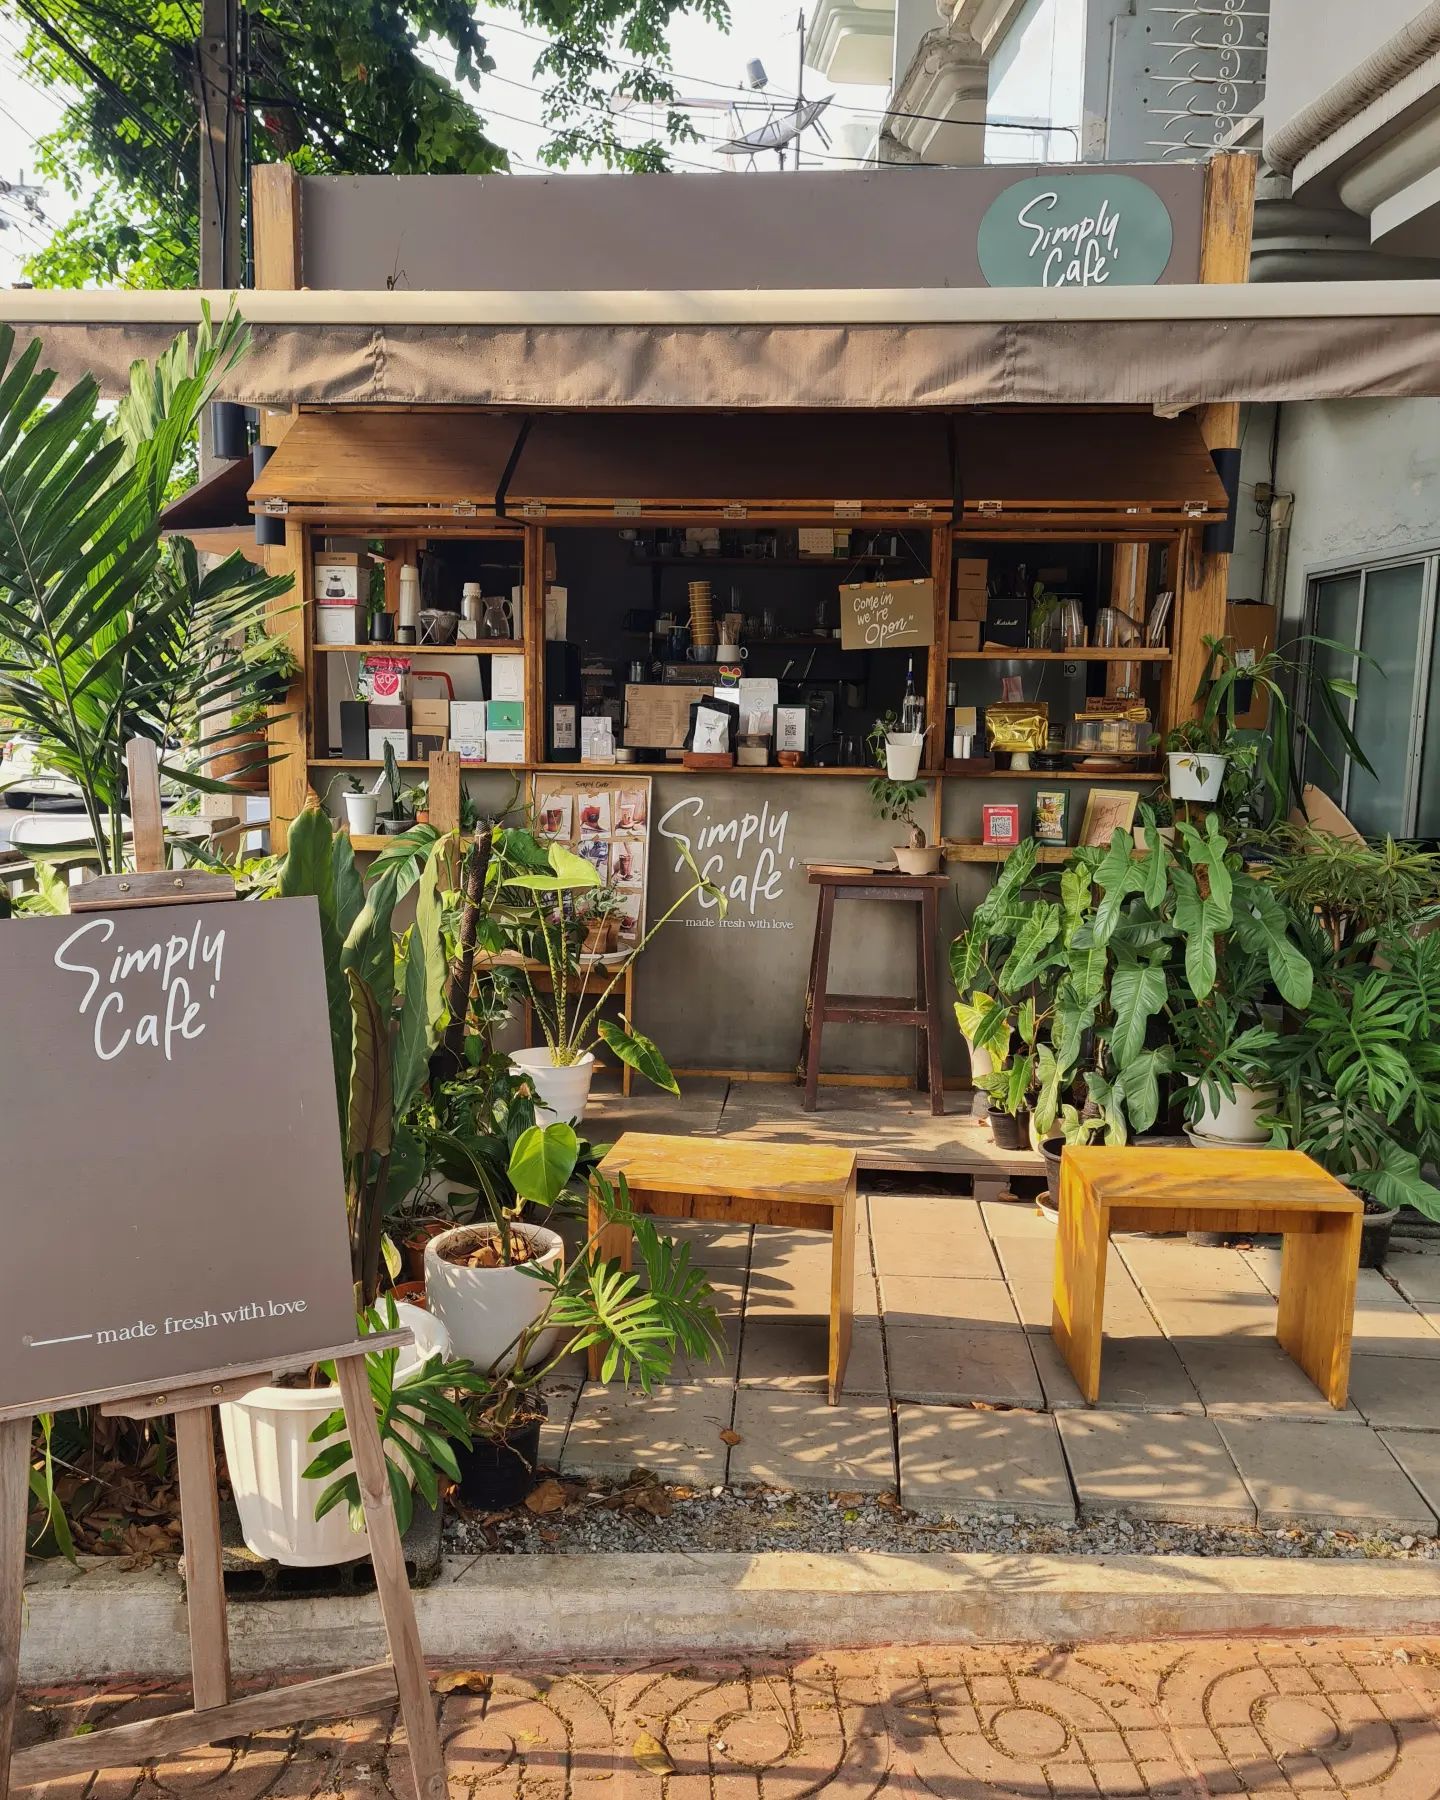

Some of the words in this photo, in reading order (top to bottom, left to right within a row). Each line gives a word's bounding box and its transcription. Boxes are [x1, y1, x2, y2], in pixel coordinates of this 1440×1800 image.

[1018, 192, 1120, 256] Simply
[853, 595, 880, 612] Come
[880, 592, 894, 606] in
[657, 796, 789, 873] Simply
[685, 917, 716, 928] made
[746, 918, 771, 930] with
[772, 918, 794, 930] love
[53, 918, 226, 1014] Simply
[95, 1320, 159, 1345] made
[162, 1310, 219, 1336] fresh
[220, 1302, 267, 1325] with
[268, 1299, 308, 1317] love
